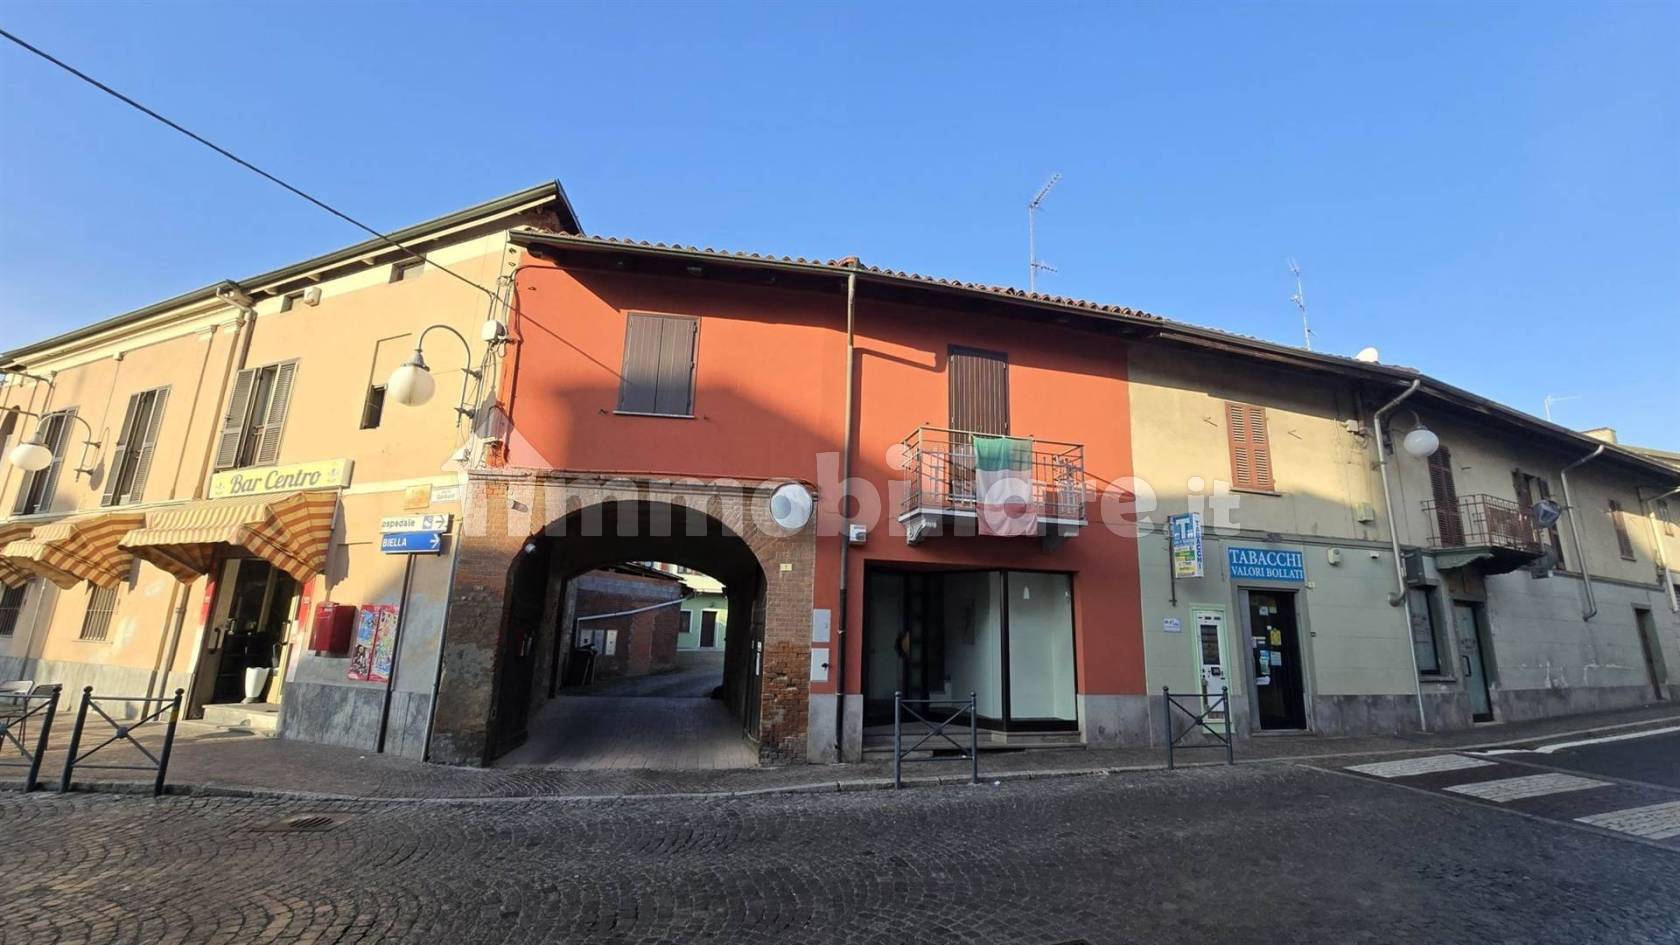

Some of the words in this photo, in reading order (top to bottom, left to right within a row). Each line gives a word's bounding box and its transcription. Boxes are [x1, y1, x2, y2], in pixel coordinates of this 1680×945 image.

[230, 474, 262, 494] Bar
[264, 469, 322, 490] Centro
[382, 537, 407, 548] BIELLA
[1229, 549, 1303, 567] TABACCHI
[1231, 565, 1265, 577] VALORI
[1266, 567, 1304, 579] BOLLATI
